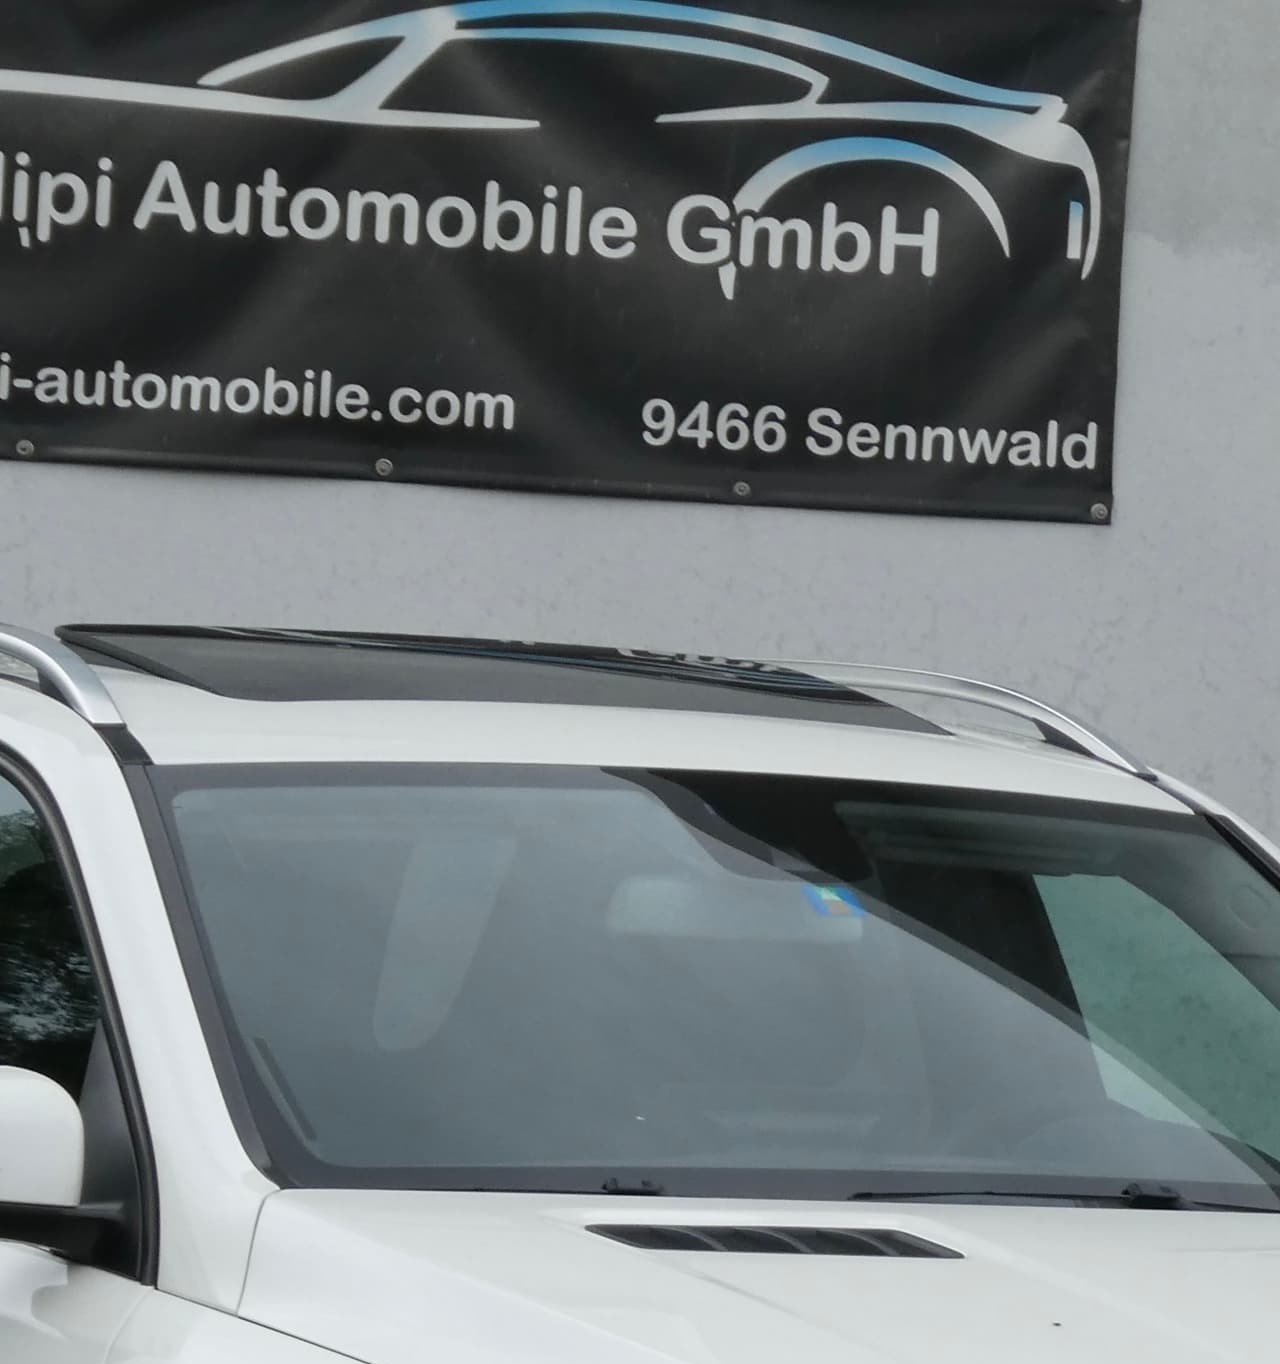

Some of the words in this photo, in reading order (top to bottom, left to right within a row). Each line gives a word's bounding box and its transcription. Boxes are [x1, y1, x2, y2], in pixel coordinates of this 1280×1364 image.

[133, 159, 639, 260] Automobile
[666, 193, 941, 279] GmbH
[641, 397, 788, 454] 9466
[804, 406, 1099, 471] Sennwald
